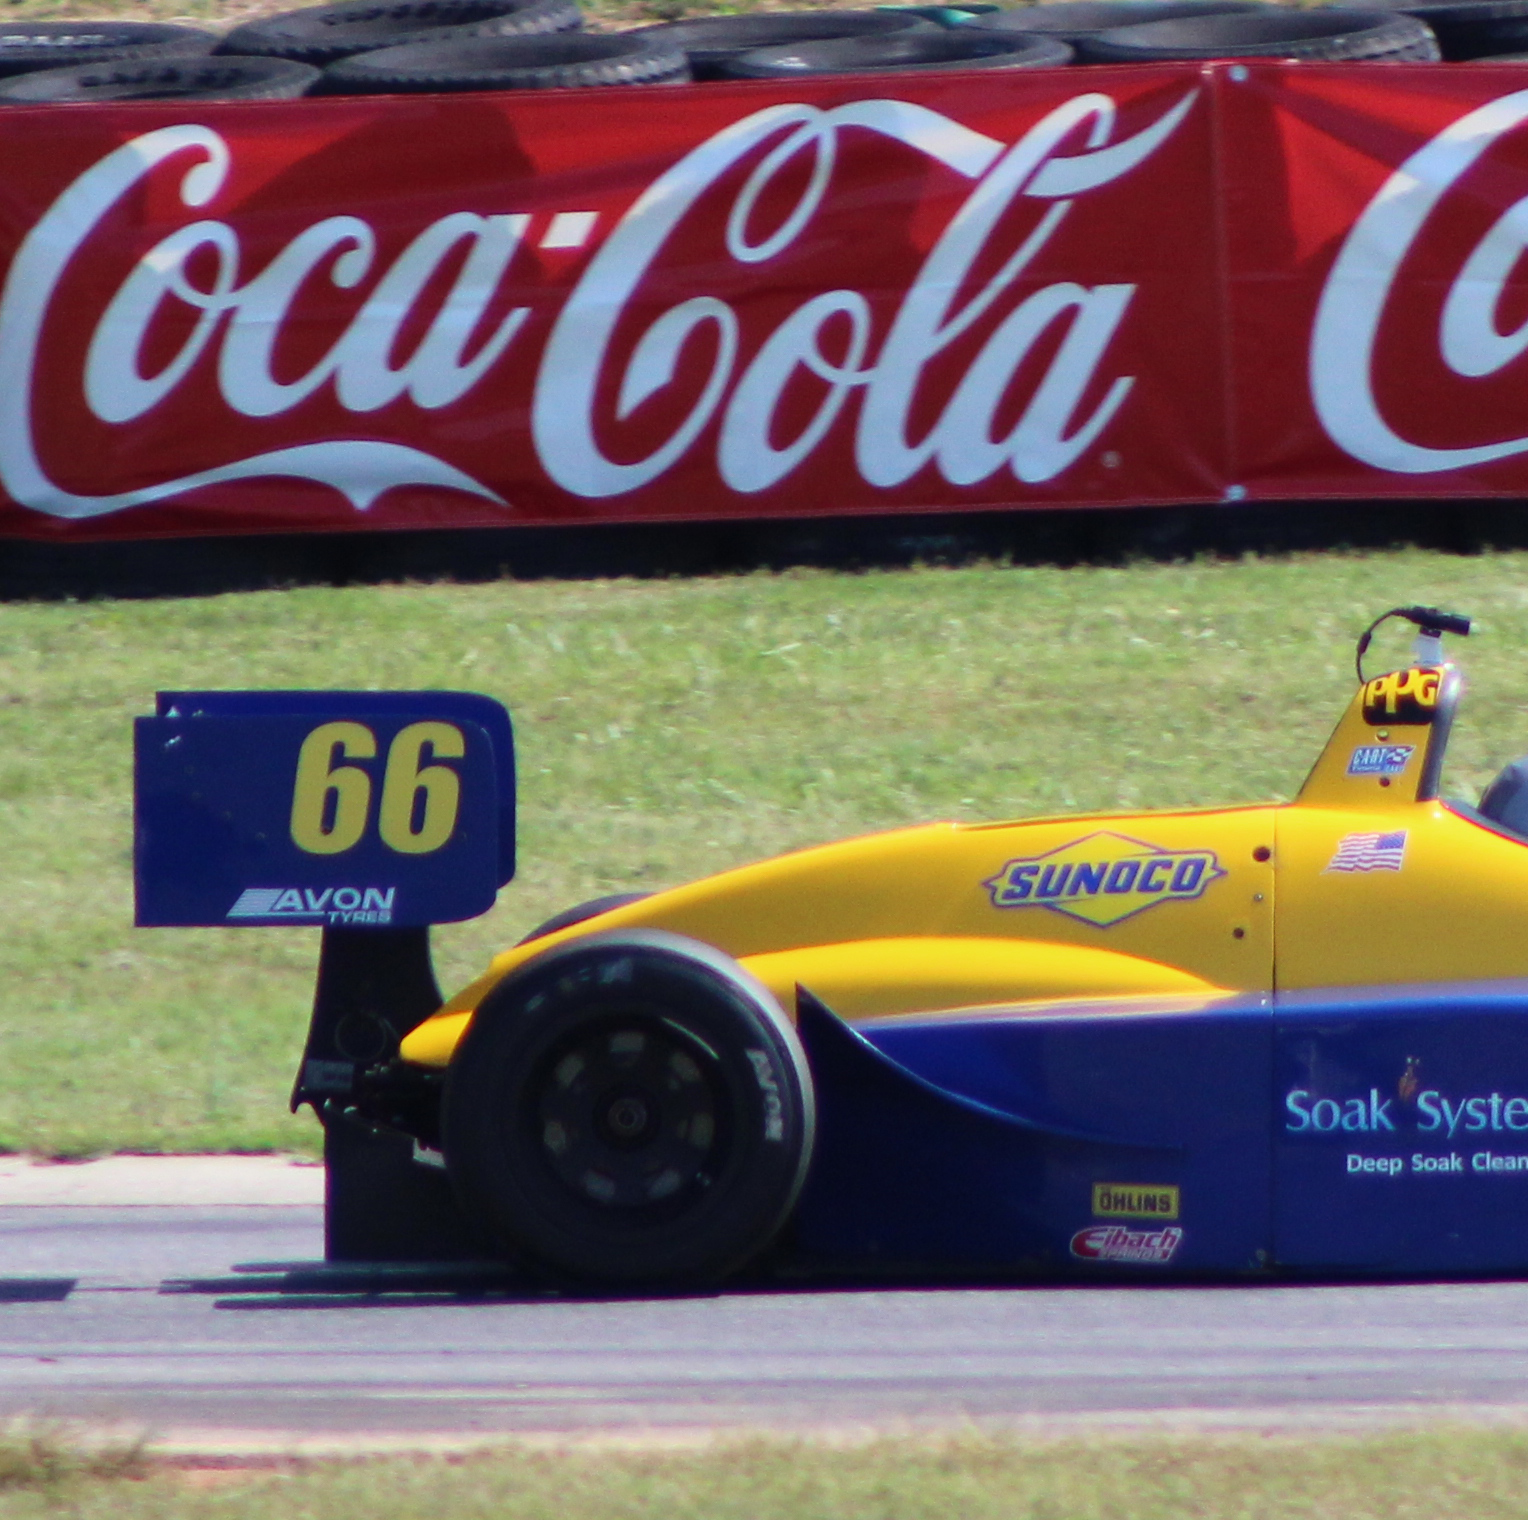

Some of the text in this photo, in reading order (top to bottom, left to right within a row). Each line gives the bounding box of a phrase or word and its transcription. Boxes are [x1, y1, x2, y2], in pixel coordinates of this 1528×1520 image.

[0, 88, 1198, 520] Coca-Cola
[1366, 669, 1437, 713] PPG
[1352, 748, 1387, 765] CART
[290, 720, 465, 855] 66
[1001, 858, 1206, 900] SUNOCO
[273, 887, 395, 911] AVON
[328, 910, 391, 923] TYRES
[1286, 1089, 1396, 1131] Soak
[1346, 1154, 1403, 1175] Deep
[1411, 1152, 1463, 1172] Soak
[1100, 1187, 1171, 1213] ÖHLINS
[1071, 1227, 1181, 1258] Eibach
